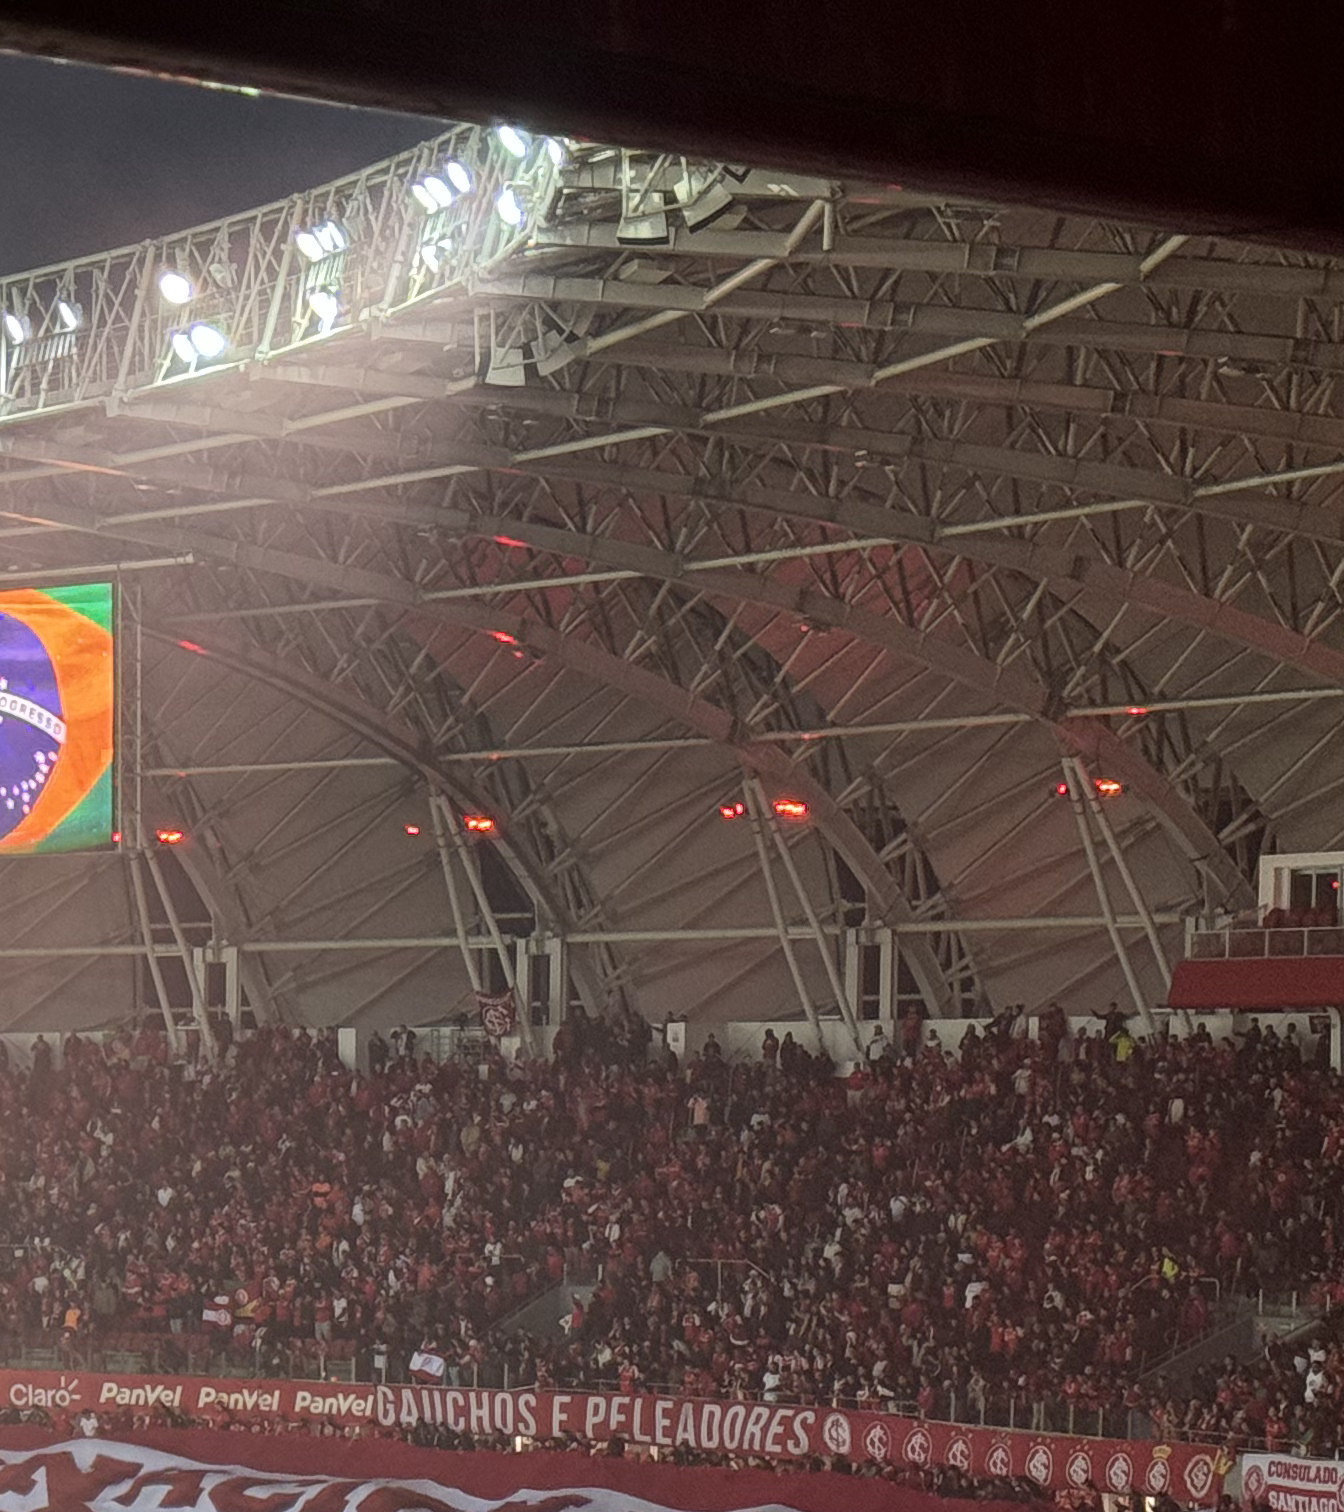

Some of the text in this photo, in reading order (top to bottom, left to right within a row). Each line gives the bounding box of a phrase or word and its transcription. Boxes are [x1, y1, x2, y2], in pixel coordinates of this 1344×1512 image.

[9, 1381, 71, 1409] Claro
[552, 1394, 572, 1436] E
[585, 1396, 816, 1456] PELEADORES
[1267, 1460, 1339, 1485] CONSULADO
